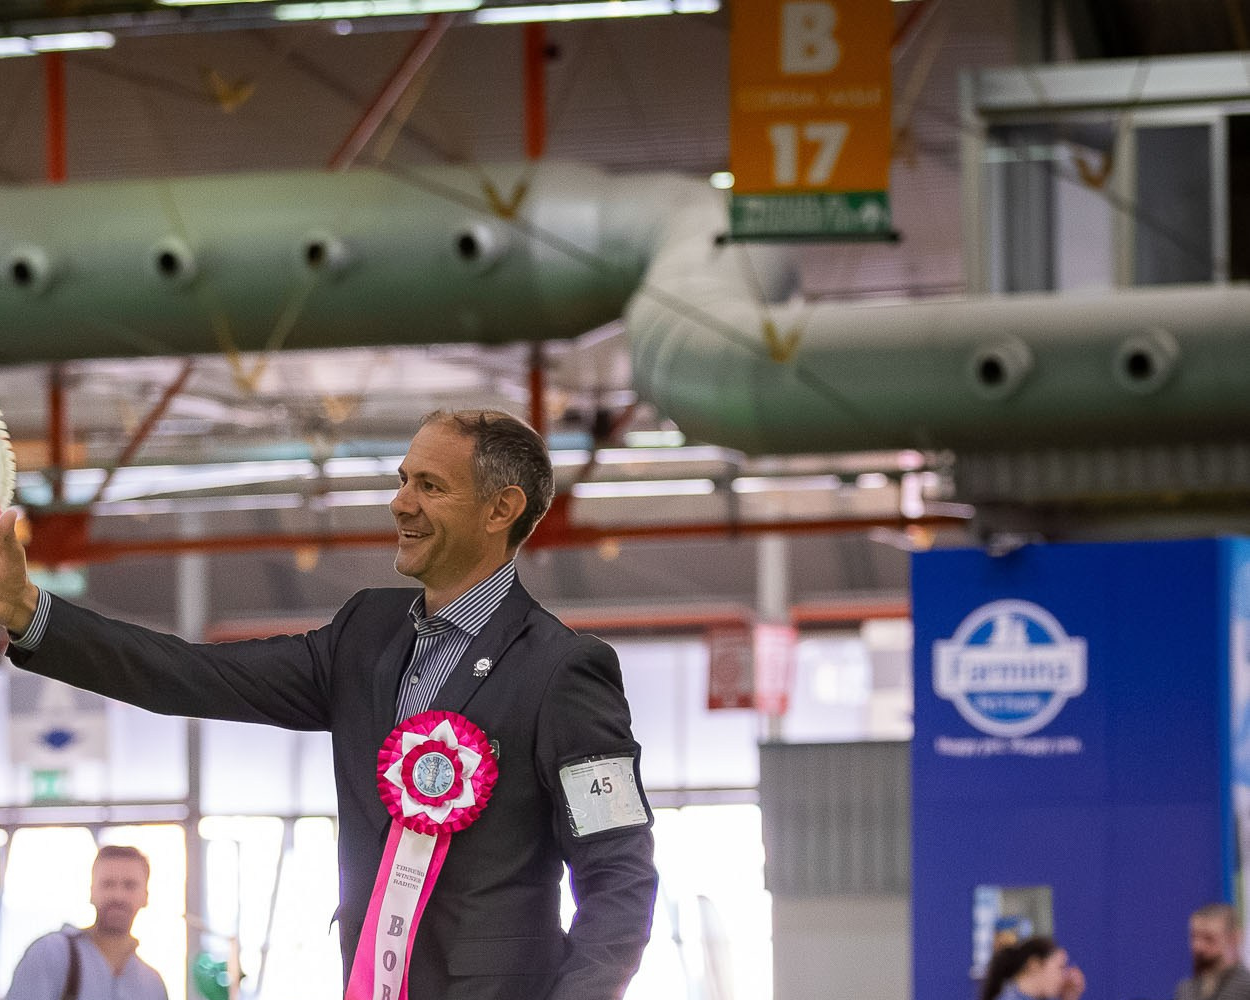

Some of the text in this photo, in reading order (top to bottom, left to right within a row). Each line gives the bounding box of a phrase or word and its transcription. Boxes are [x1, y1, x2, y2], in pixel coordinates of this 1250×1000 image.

[781, 3, 841, 74] B
[769, 123, 850, 186] 17
[590, 777, 613, 796] 45
